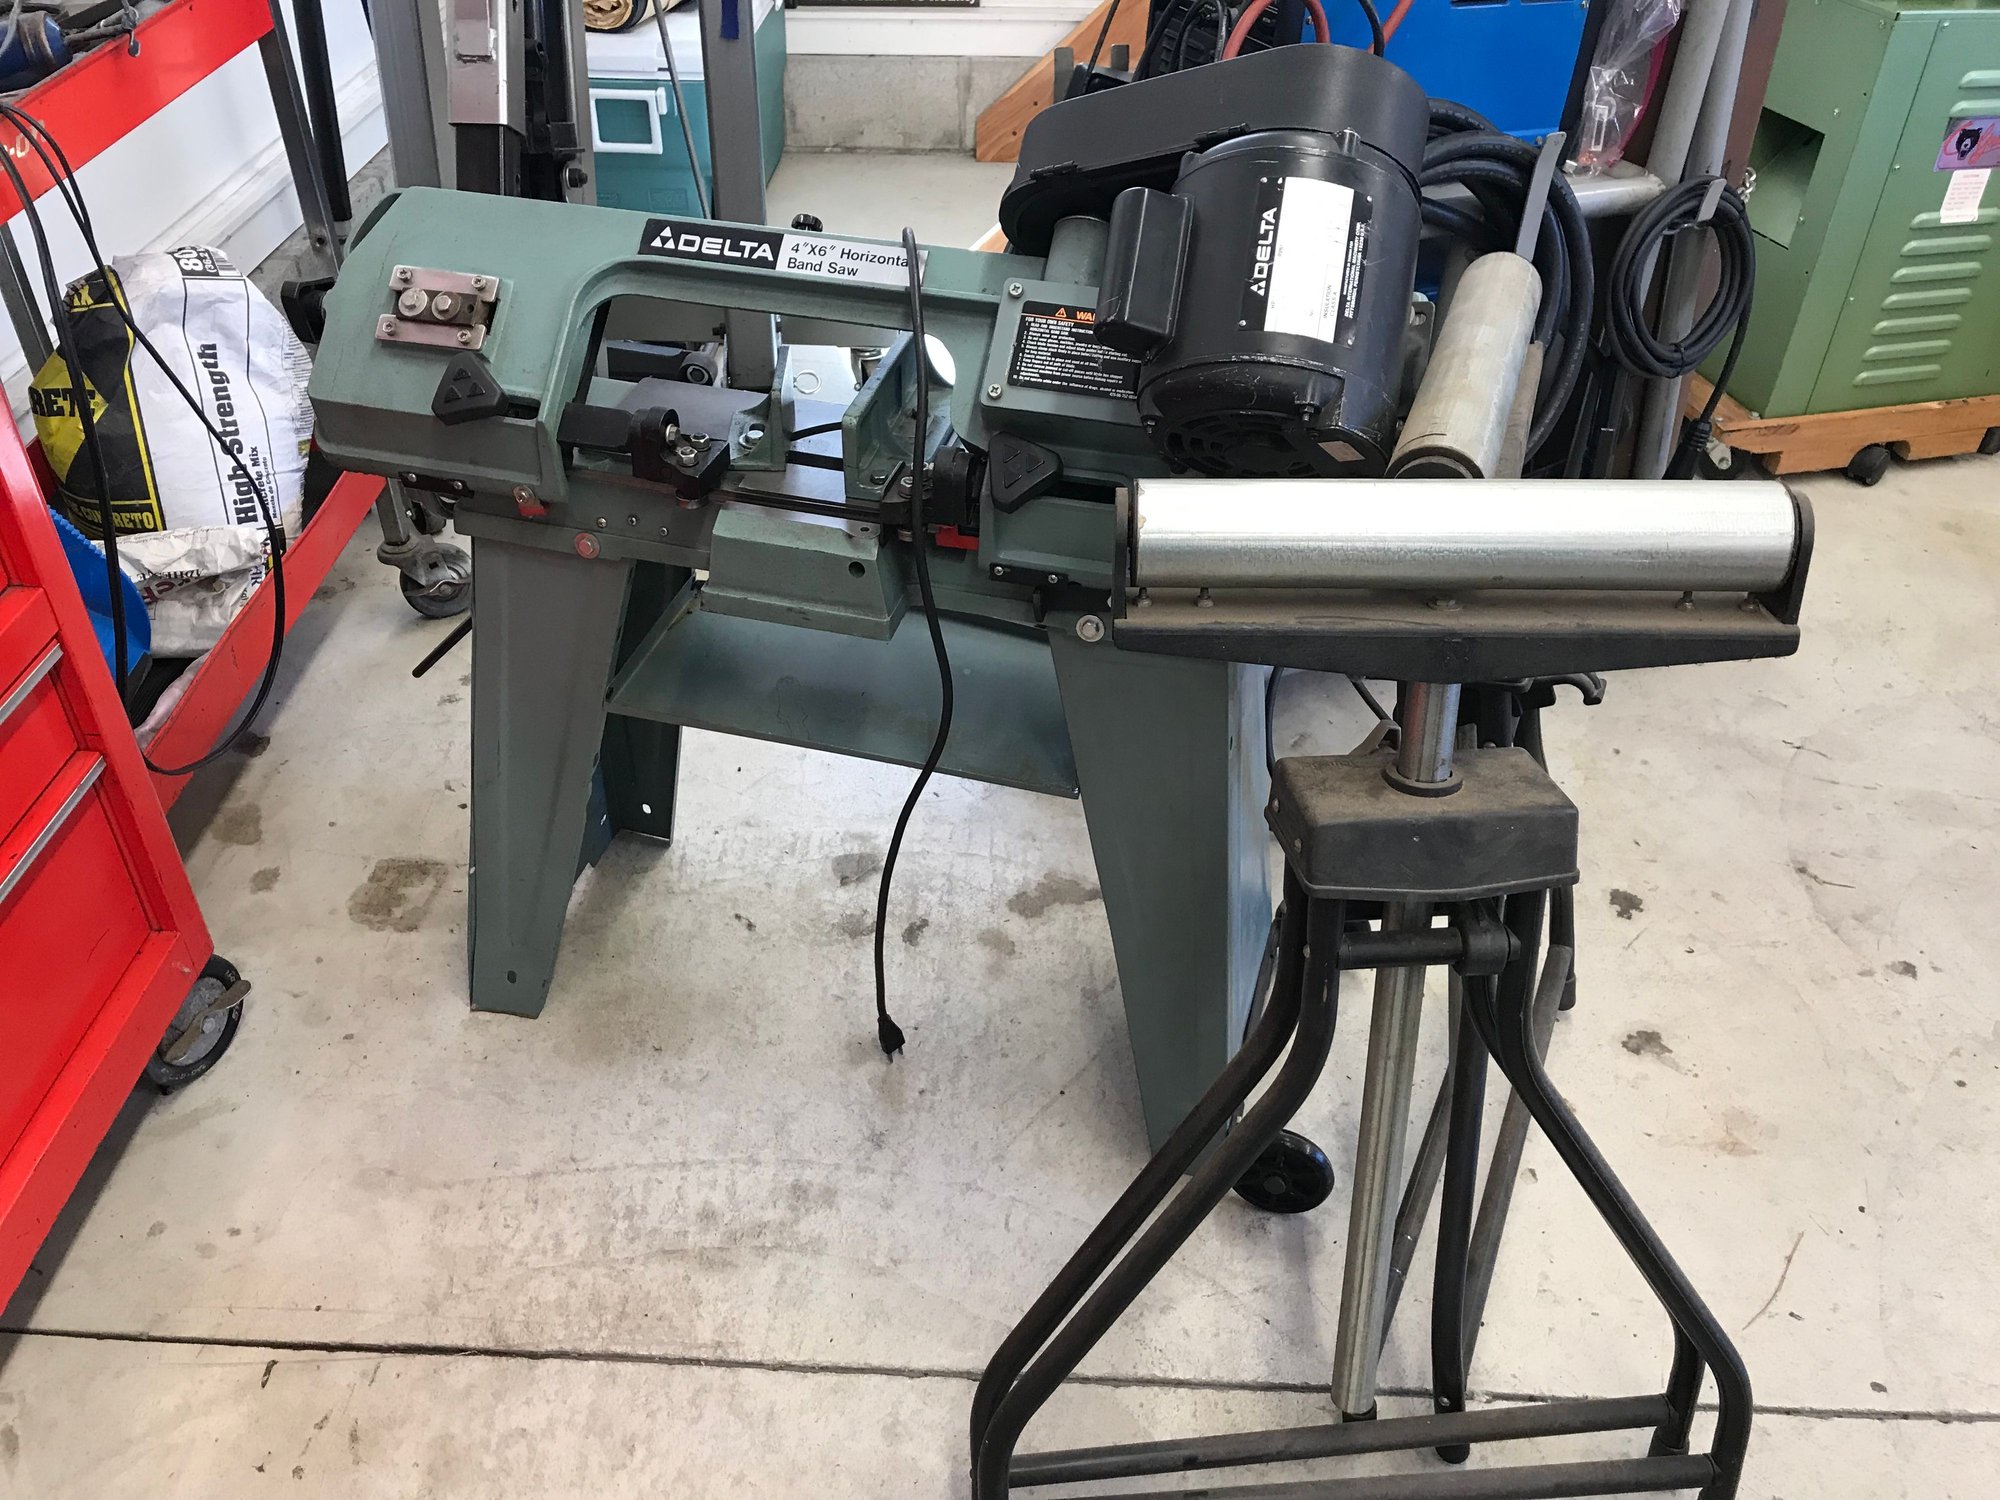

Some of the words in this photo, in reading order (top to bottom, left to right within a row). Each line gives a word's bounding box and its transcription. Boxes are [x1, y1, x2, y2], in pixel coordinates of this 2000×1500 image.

[676, 234, 774, 262] DELTA
[1253, 206, 1277, 279] DELTA
[787, 257, 822, 273] Band
[827, 261, 859, 277] Saw
[840, 247, 909, 268] Horizonta
[199, 343, 243, 455] Strength
[249, 446, 261, 467] Mix
[227, 463, 258, 525] High
